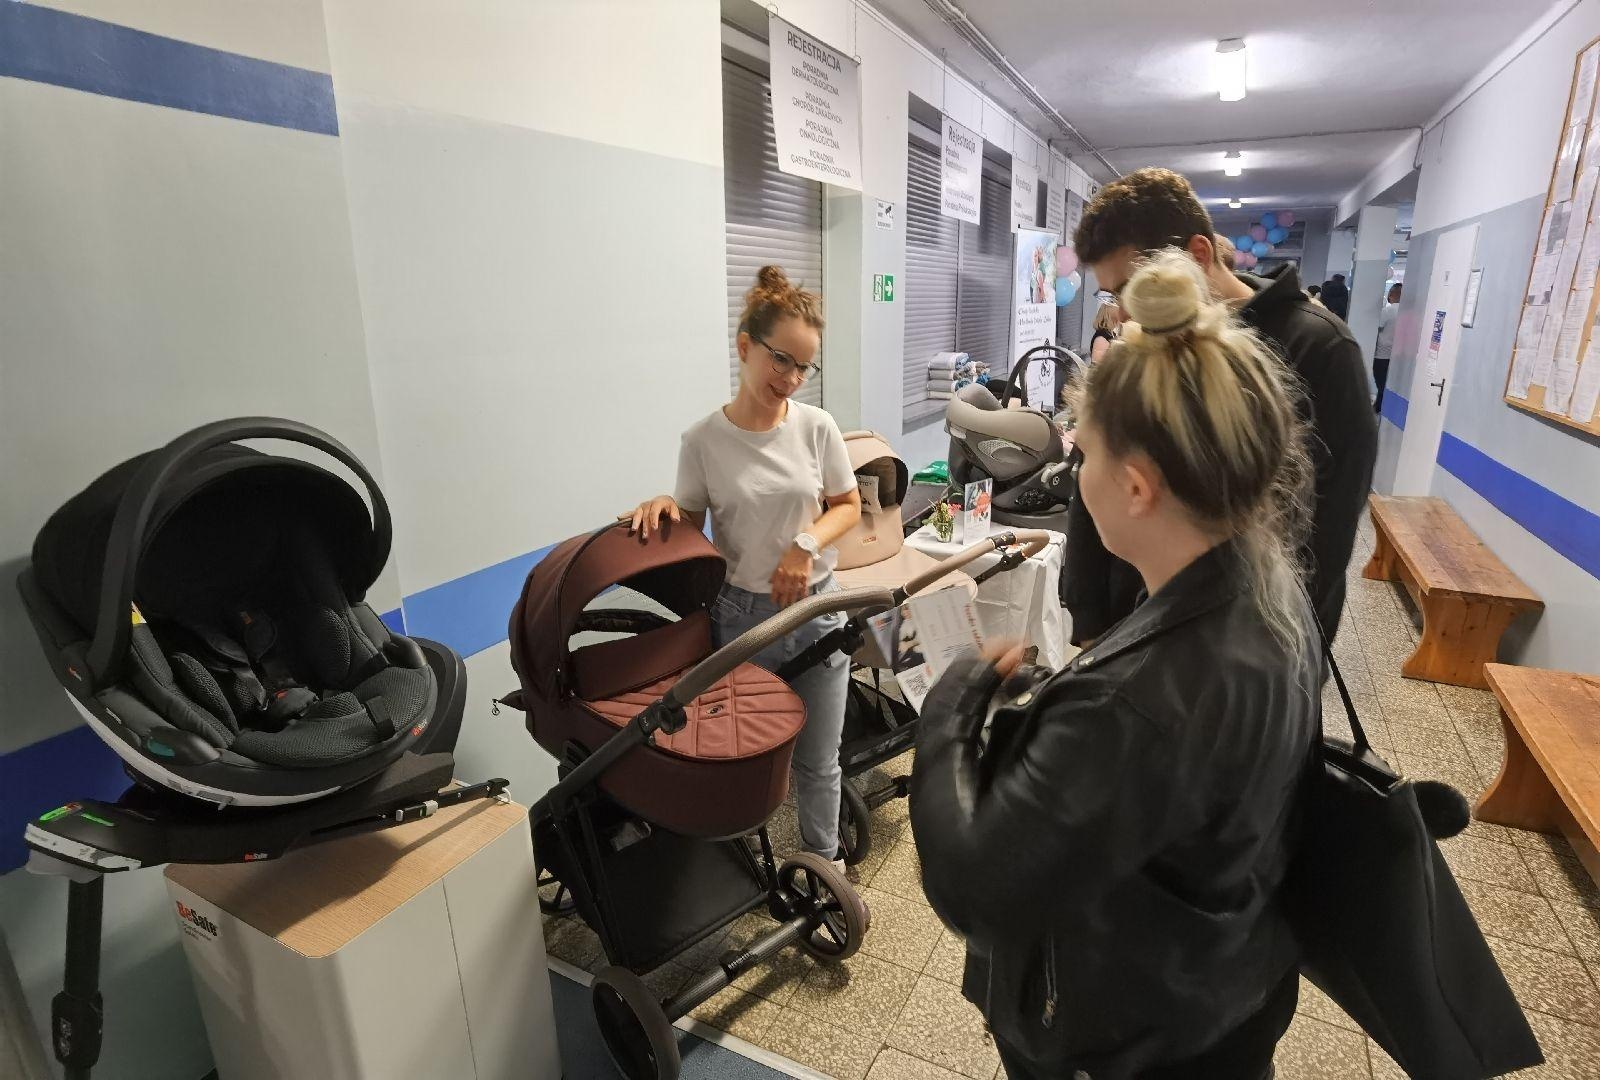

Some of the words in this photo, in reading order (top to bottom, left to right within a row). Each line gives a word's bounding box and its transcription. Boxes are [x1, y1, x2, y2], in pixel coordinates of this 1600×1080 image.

[787, 30, 842, 73] REJESTRACJA
[791, 65, 840, 97] DERMATOLOGICZNA
[802, 60, 829, 81] PORADNIA
[805, 91, 831, 110] PORADNIA
[805, 119, 833, 138] PORADNIA
[175, 900, 218, 937] BeSafe
